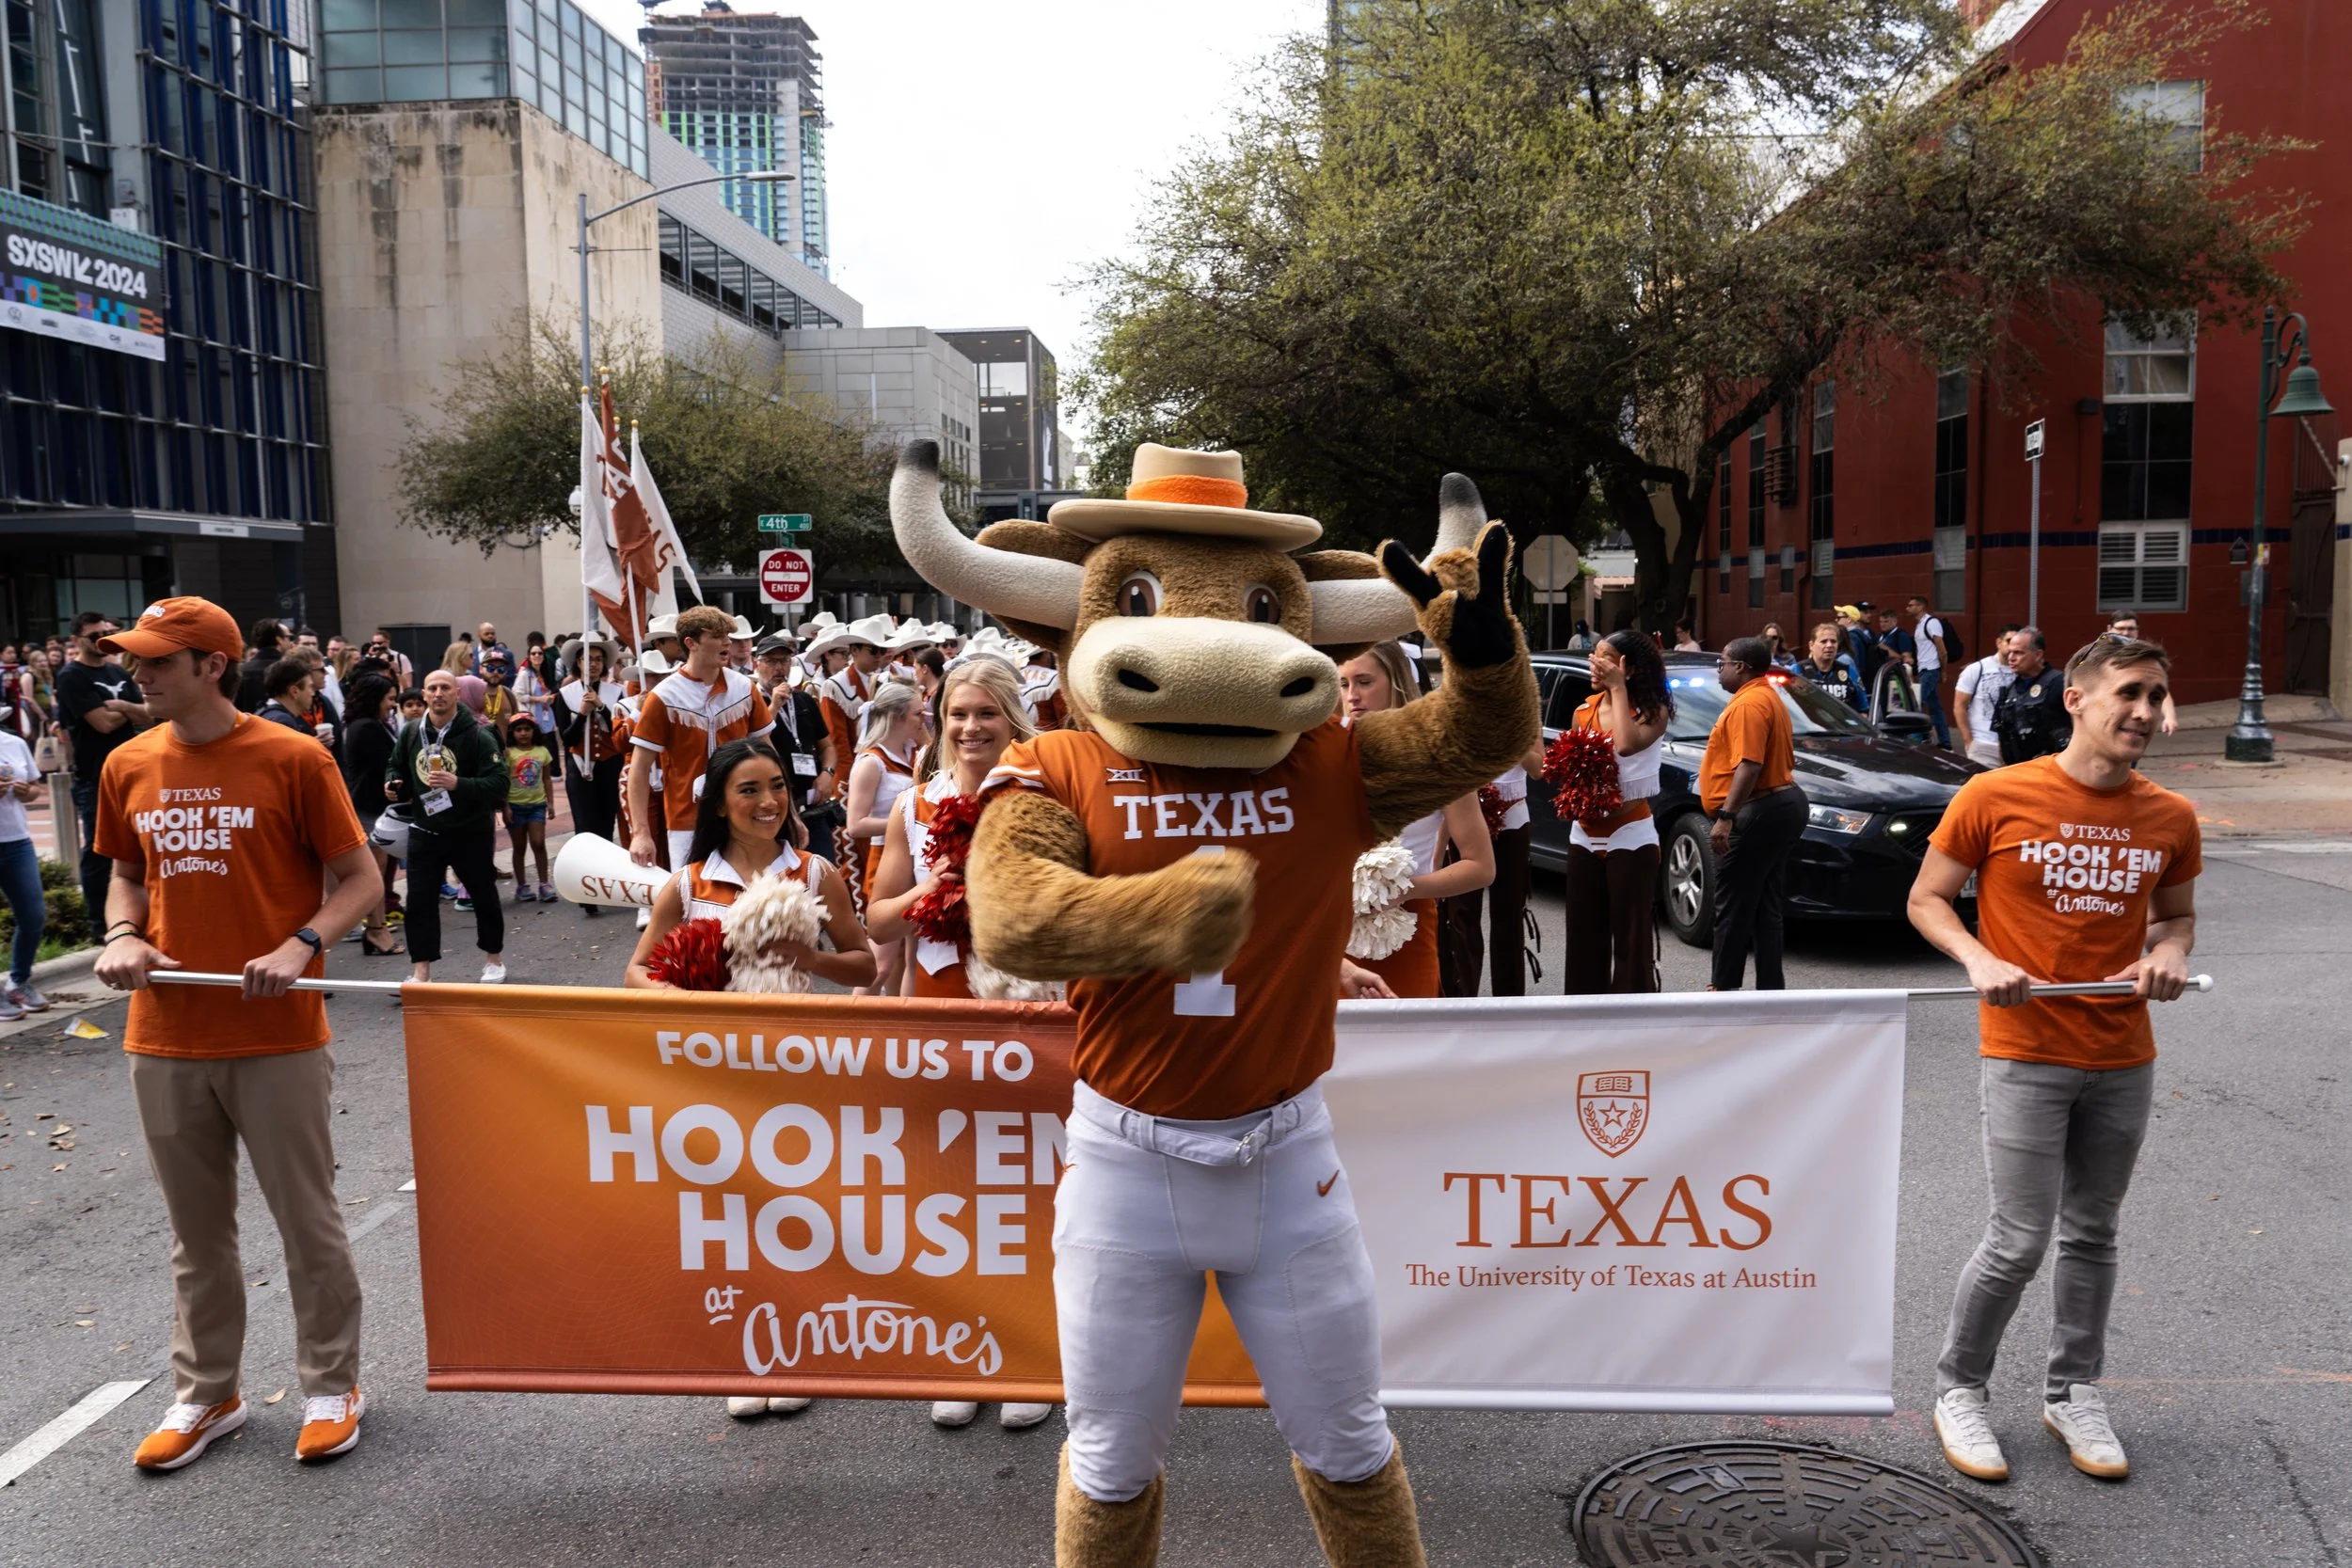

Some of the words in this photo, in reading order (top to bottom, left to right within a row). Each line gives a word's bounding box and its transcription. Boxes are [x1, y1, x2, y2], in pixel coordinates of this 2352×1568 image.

[8, 233, 72, 279] SXSW
[93, 259, 148, 299] 2024
[766, 517, 788, 529] 4th
[768, 561, 782, 570] DO
[786, 561, 804, 570] NOT
[771, 583, 801, 593] ENTER
[172, 787, 221, 802] TEXAS
[135, 808, 204, 834] HOOK
[209, 806, 255, 829] 'EM
[1113, 786, 1295, 840] TEXAS
[152, 829, 232, 853] HOUSE
[2075, 824, 2131, 842] TEXAS
[2019, 840, 2111, 868] HOOK
[2118, 847, 2162, 874] 'EM
[580, 875, 656, 906] EXAS
[2042, 863, 2141, 894] HOUSE
[657, 1030, 873, 1077] FOLLOW
[885, 1037, 949, 1081] US
[961, 1039, 1034, 1082] TO
[584, 1103, 906, 1188] HOOK
[1443, 1172, 1772, 1251] TEXAS
[678, 1191, 1027, 1277] HOUSE
[1406, 1263, 1451, 1287] The
[1457, 1264, 1586, 1292] University
[1590, 1264, 1617, 1287] of
[1624, 1264, 1695, 1289] Texas
[1703, 1271, 1727, 1289] at
[1732, 1267, 1817, 1289] Austin
[704, 1285, 744, 1325] at
